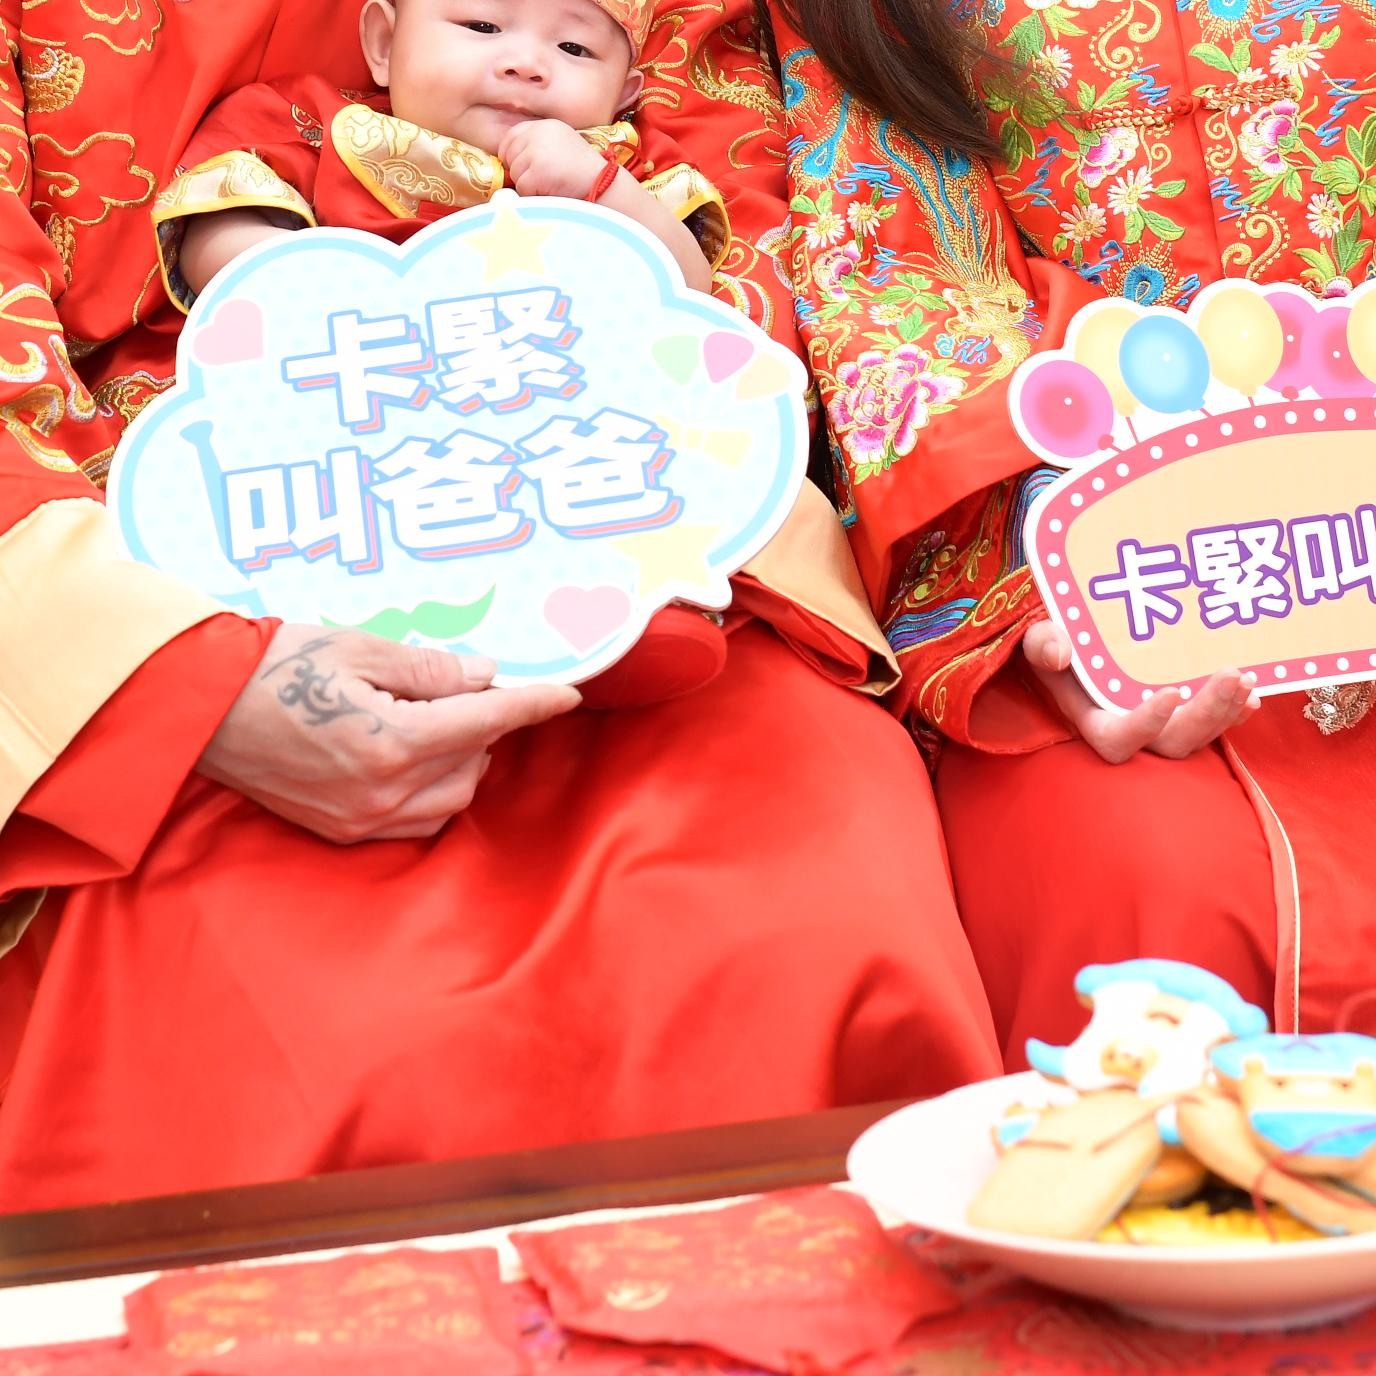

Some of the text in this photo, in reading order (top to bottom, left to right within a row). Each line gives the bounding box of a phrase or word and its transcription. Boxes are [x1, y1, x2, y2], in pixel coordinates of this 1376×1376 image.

[281, 285, 581, 433] 卡緊
[222, 407, 683, 574] 叫爸爸
